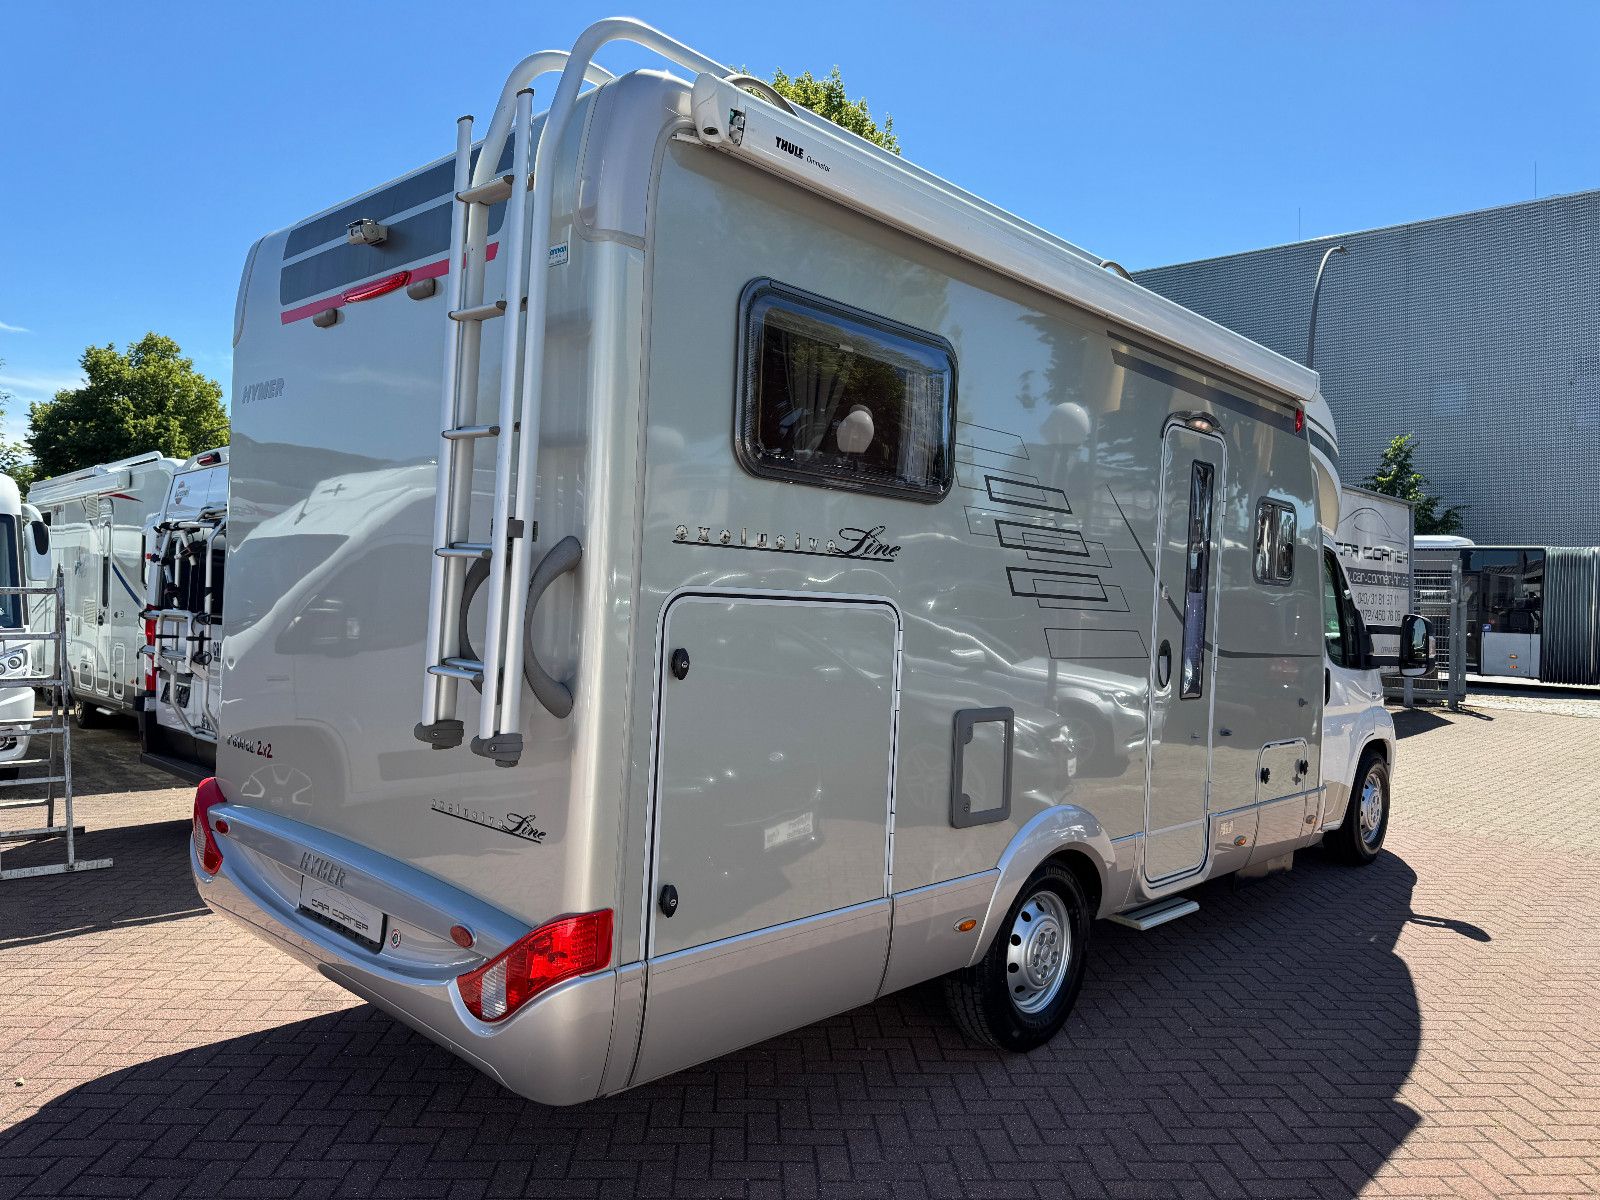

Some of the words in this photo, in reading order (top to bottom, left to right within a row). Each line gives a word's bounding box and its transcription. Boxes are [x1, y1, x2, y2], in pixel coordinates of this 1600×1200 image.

[775, 135, 804, 159] THULE
[241, 377, 285, 404] HYMER
[675, 524, 837, 553] exclusive
[836, 525, 902, 558] Line
[256, 740, 273, 759] 2x2
[502, 812, 547, 841] Line
[300, 851, 347, 888] HYMER
[311, 898, 330, 912] CAR
[332, 908, 369, 931] CORNER
